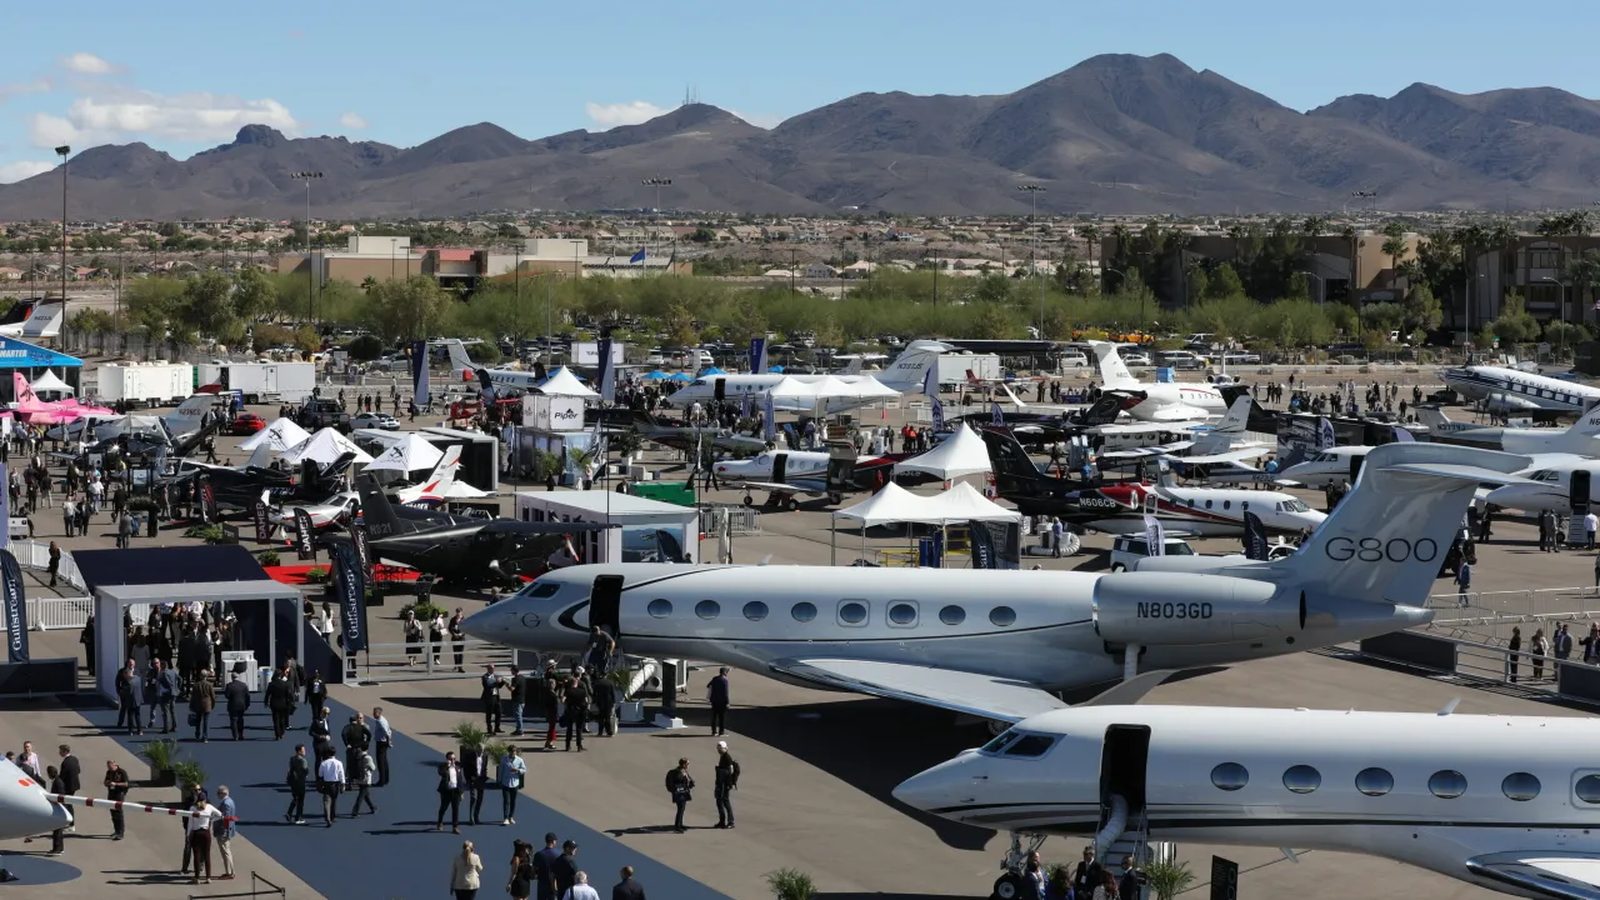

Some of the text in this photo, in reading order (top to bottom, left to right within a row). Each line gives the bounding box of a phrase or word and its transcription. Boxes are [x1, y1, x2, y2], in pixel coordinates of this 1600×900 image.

[554, 411, 578, 421] Piper
[256, 503, 268, 540] DAHER
[299, 515, 311, 552] DAHER
[1325, 536, 1438, 562] G800
[8, 579, 22, 651] Gulfstream
[347, 569, 359, 639] Gulfstream
[1137, 602, 1213, 619] N803GD
